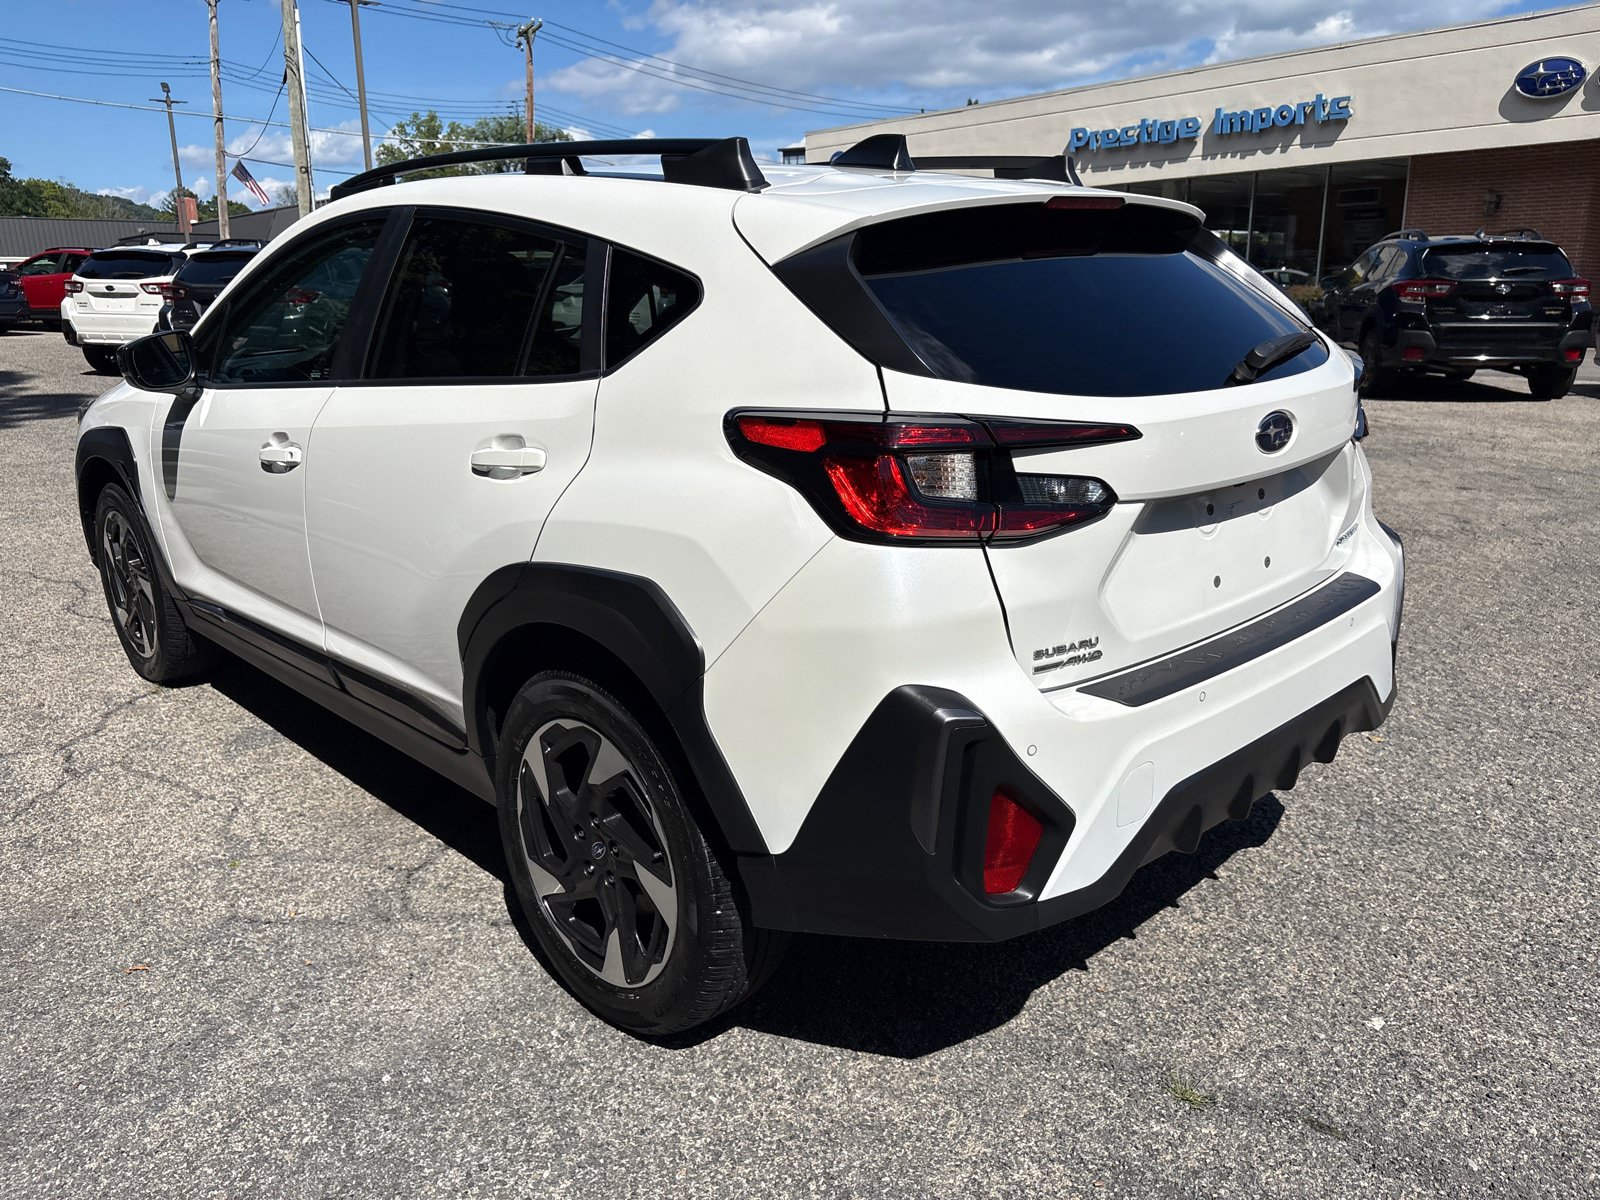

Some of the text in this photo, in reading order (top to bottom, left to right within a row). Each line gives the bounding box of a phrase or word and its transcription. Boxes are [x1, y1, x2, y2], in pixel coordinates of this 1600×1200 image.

[1069, 93, 1353, 153] Prestige Imports
[1033, 636, 1099, 660] SUBARU
[1060, 650, 1103, 669] AWD
